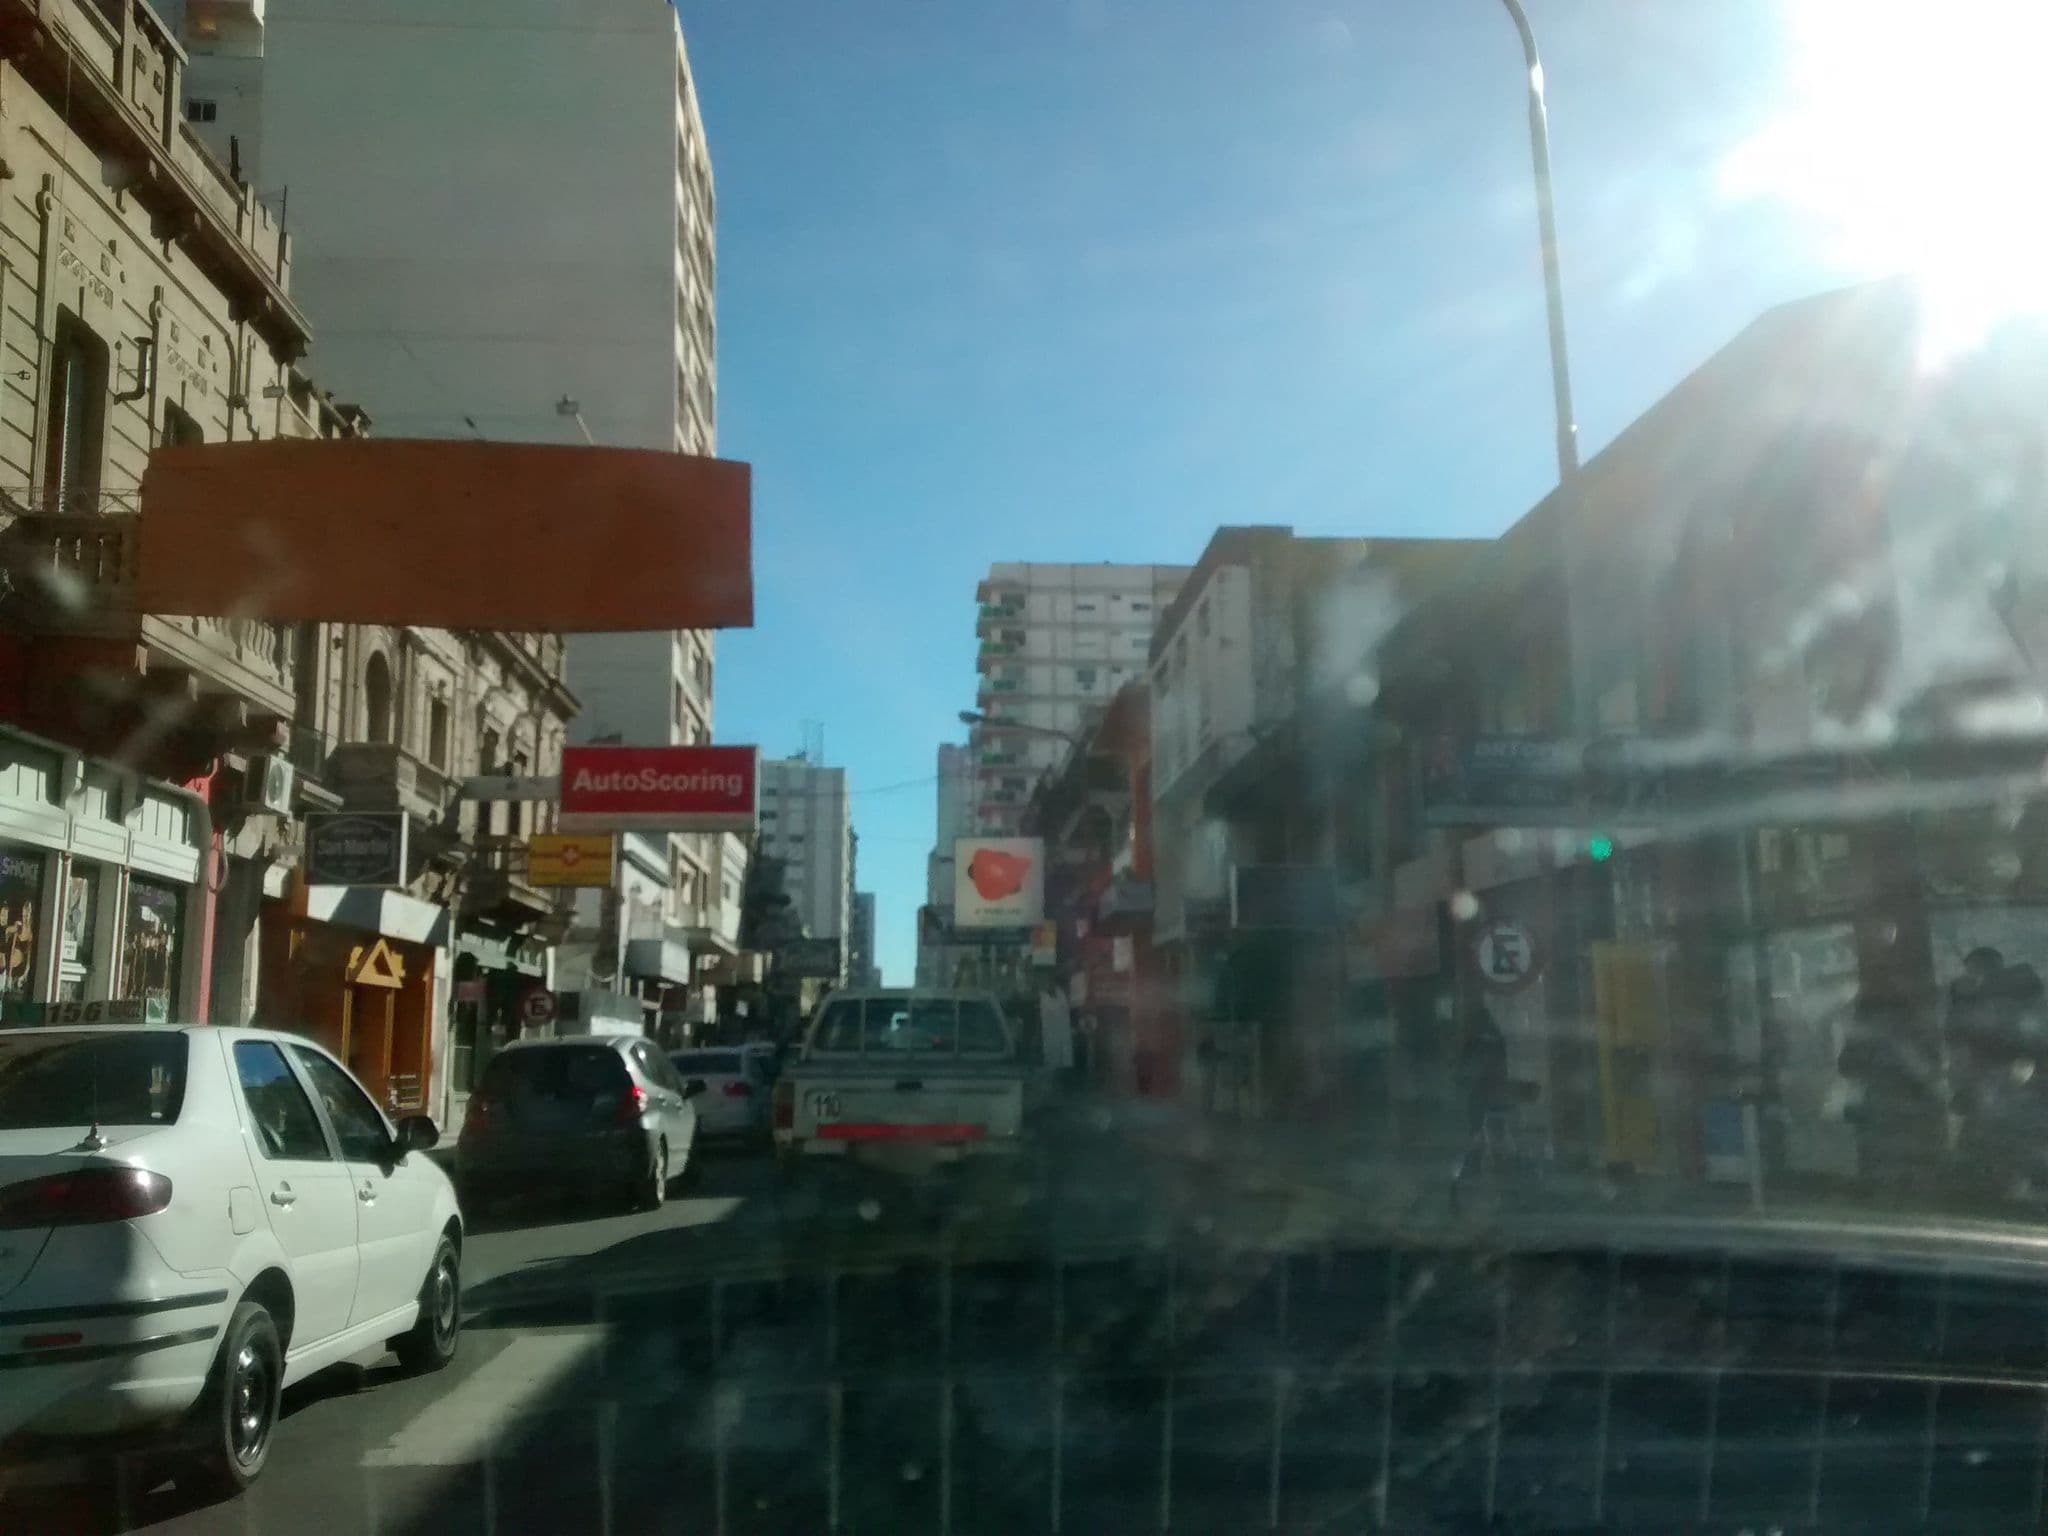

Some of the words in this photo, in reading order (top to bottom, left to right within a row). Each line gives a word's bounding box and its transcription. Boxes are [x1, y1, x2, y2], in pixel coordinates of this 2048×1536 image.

[572, 766, 743, 797] AutoScoring
[48, 1001, 104, 1023] 156
[814, 1095, 842, 1118] 110
